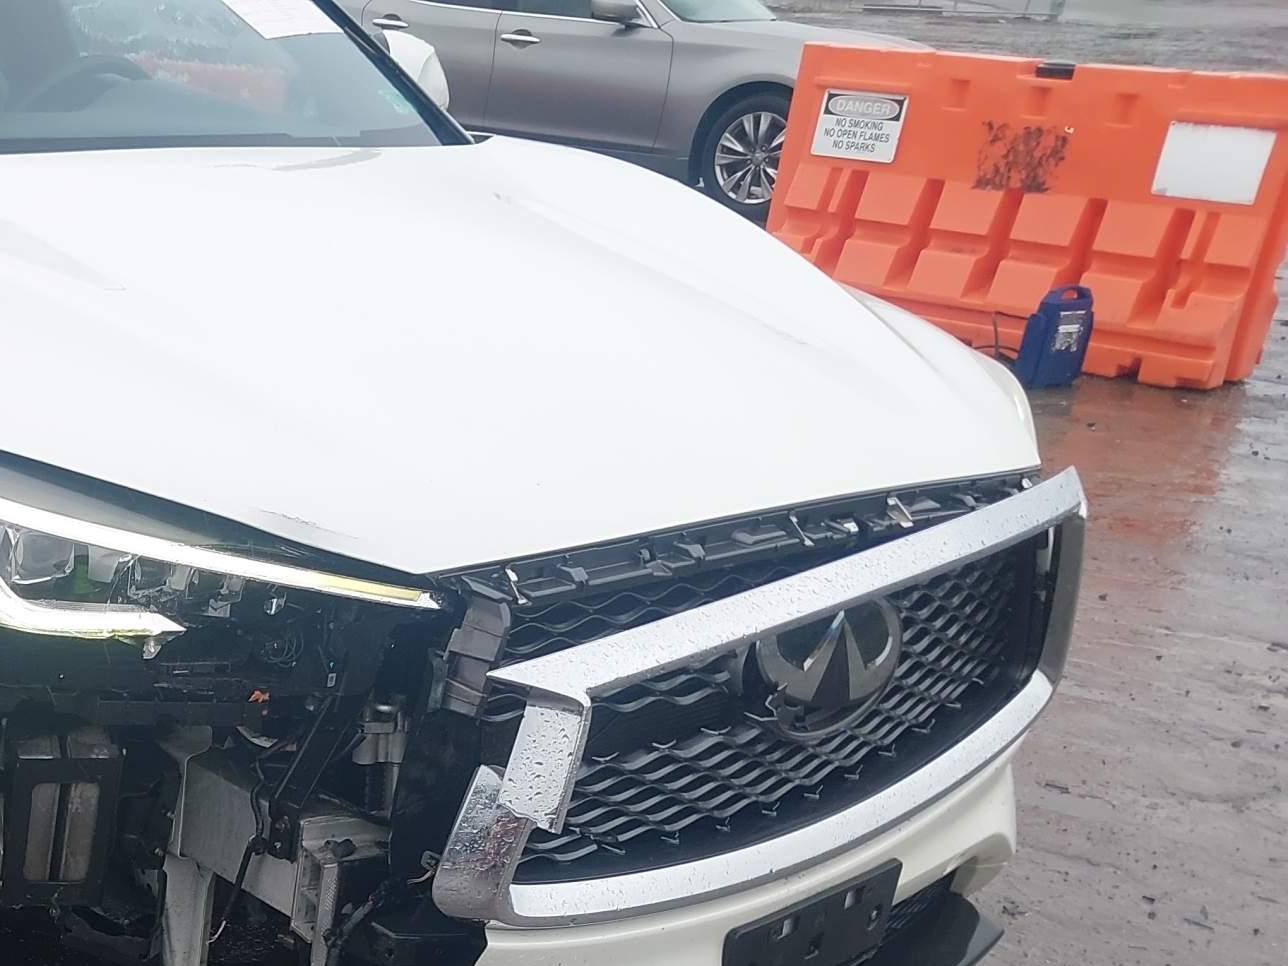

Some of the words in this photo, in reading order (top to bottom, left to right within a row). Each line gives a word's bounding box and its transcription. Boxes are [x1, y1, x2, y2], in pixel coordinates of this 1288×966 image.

[836, 100, 890, 115] DANGER
[835, 118, 847, 128] NO
[848, 119, 883, 132] SMOKING
[824, 128, 835, 137] NO
[836, 129, 858, 140] OPEN
[859, 131, 890, 143] FLAMES
[832, 140, 844, 149] NO
[845, 141, 876, 153] SPARKS
